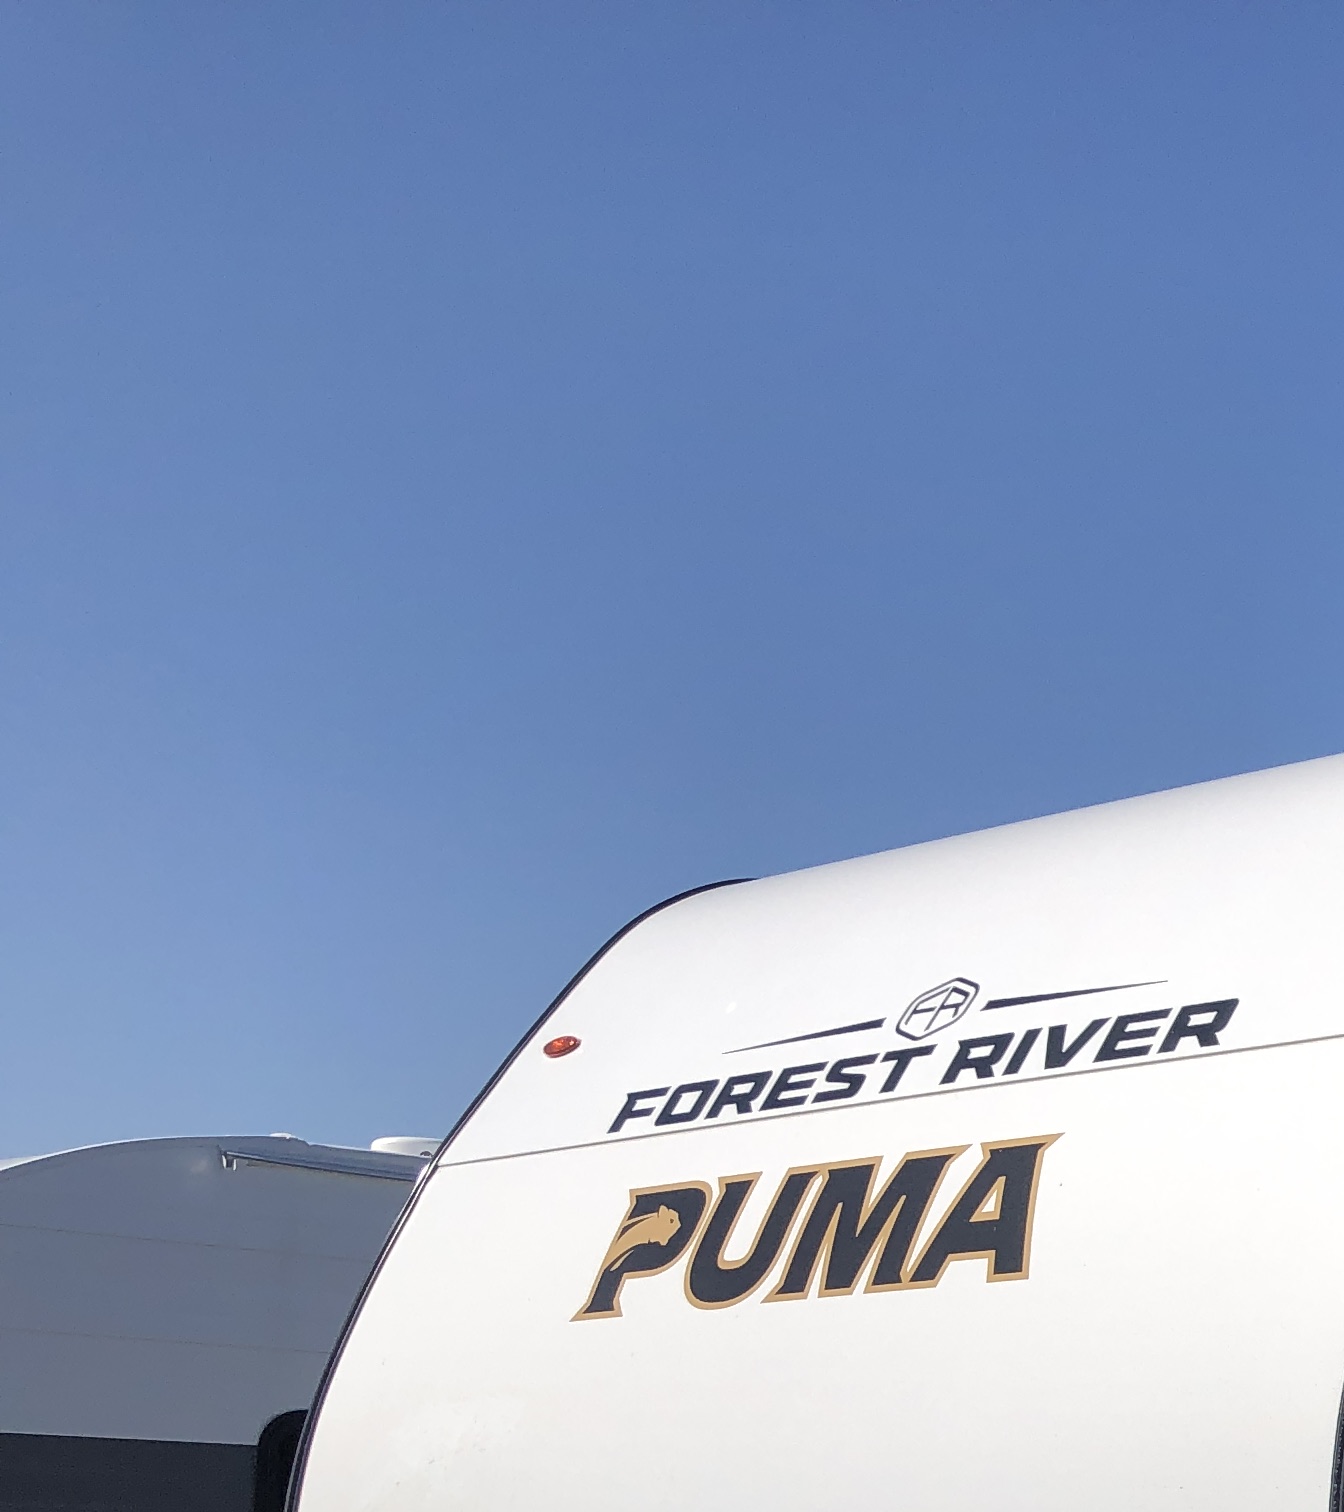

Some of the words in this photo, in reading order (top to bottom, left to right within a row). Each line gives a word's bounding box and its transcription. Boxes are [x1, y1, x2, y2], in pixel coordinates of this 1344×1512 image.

[607, 1044, 938, 1134] FOREST
[940, 997, 1240, 1085] RIVER
[570, 1132, 1065, 1322] PUMA
